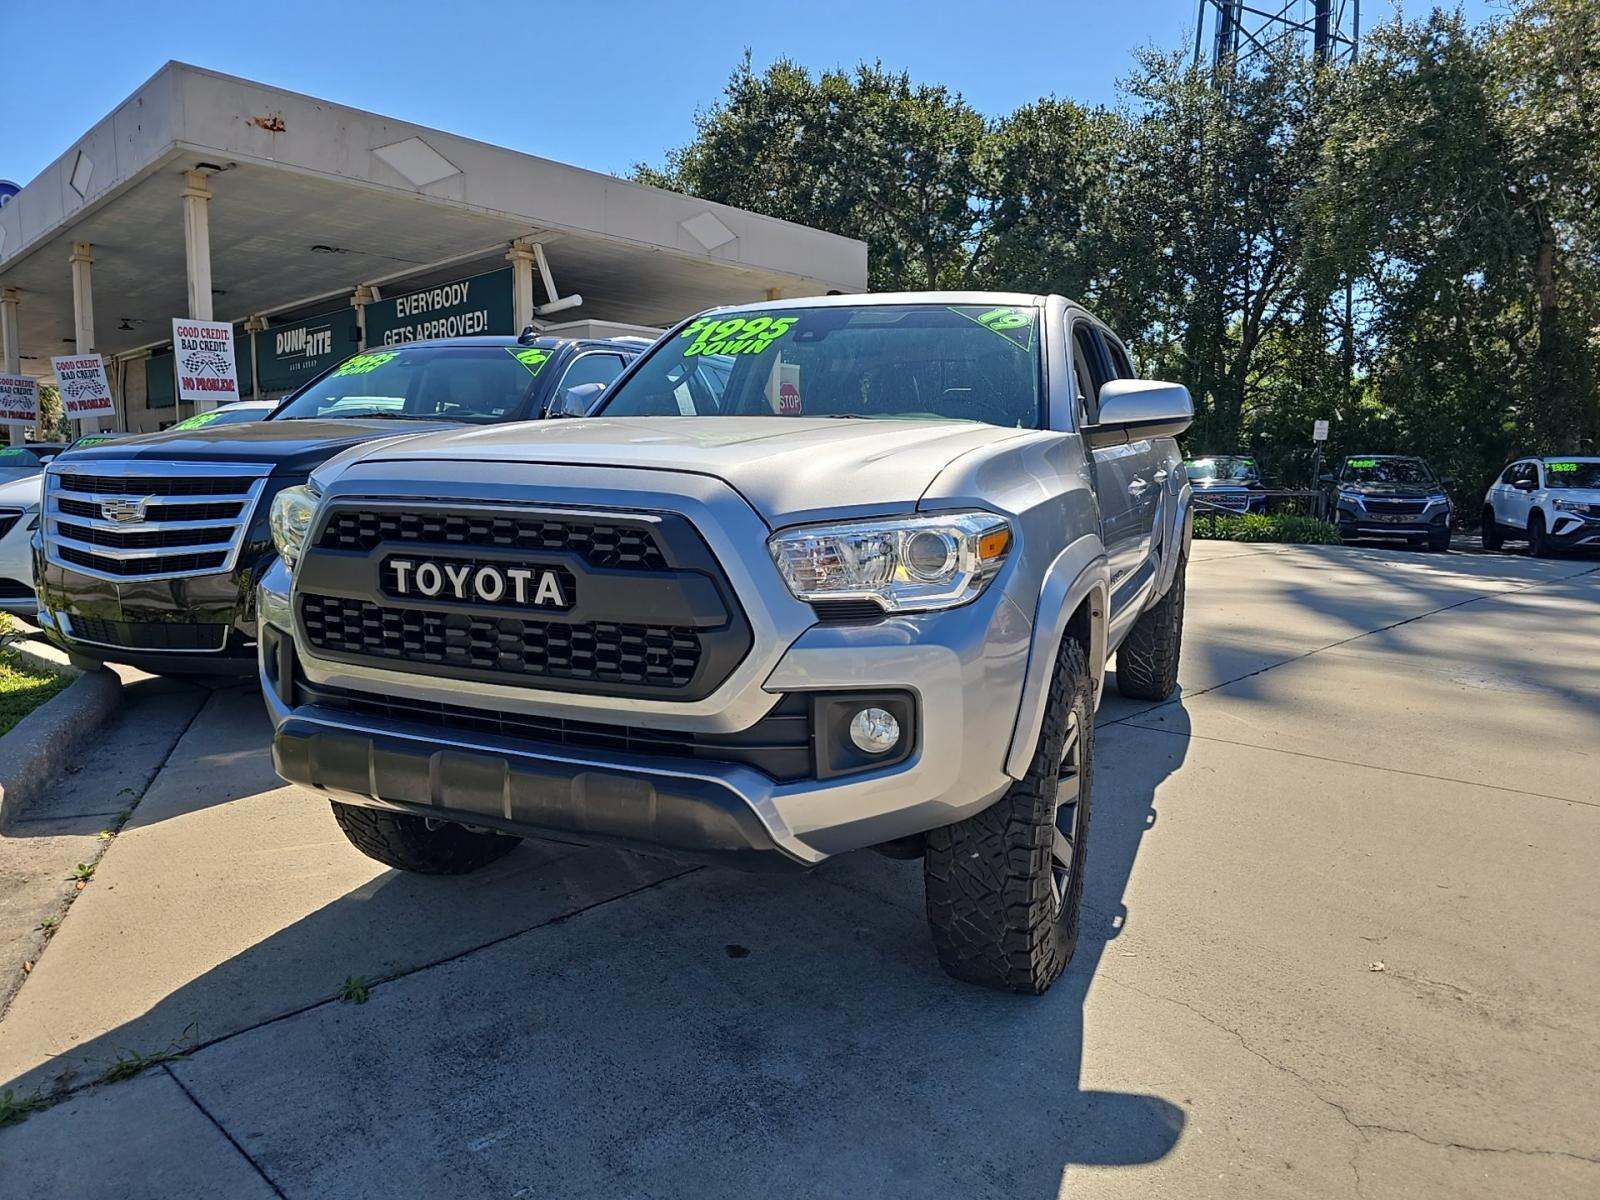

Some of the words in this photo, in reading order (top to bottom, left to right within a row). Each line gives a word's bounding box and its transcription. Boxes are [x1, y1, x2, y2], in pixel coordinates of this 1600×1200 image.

[396, 281, 469, 318] EVERYBODY
[177, 326, 199, 338] GOOD
[384, 326, 413, 346] GETS
[416, 310, 488, 341] APPROVED!
[681, 316, 800, 343] $1995
[181, 339, 198, 350] BAD
[683, 339, 774, 357] DOWN
[56, 361, 75, 371] GOOD
[61, 371, 76, 380] BAD
[182, 376, 195, 391] NO
[195, 377, 236, 392] PROBLEM!
[66, 401, 78, 412] NO
[780, 395, 800, 410] STOP
[390, 560, 568, 606] TOYOTA
